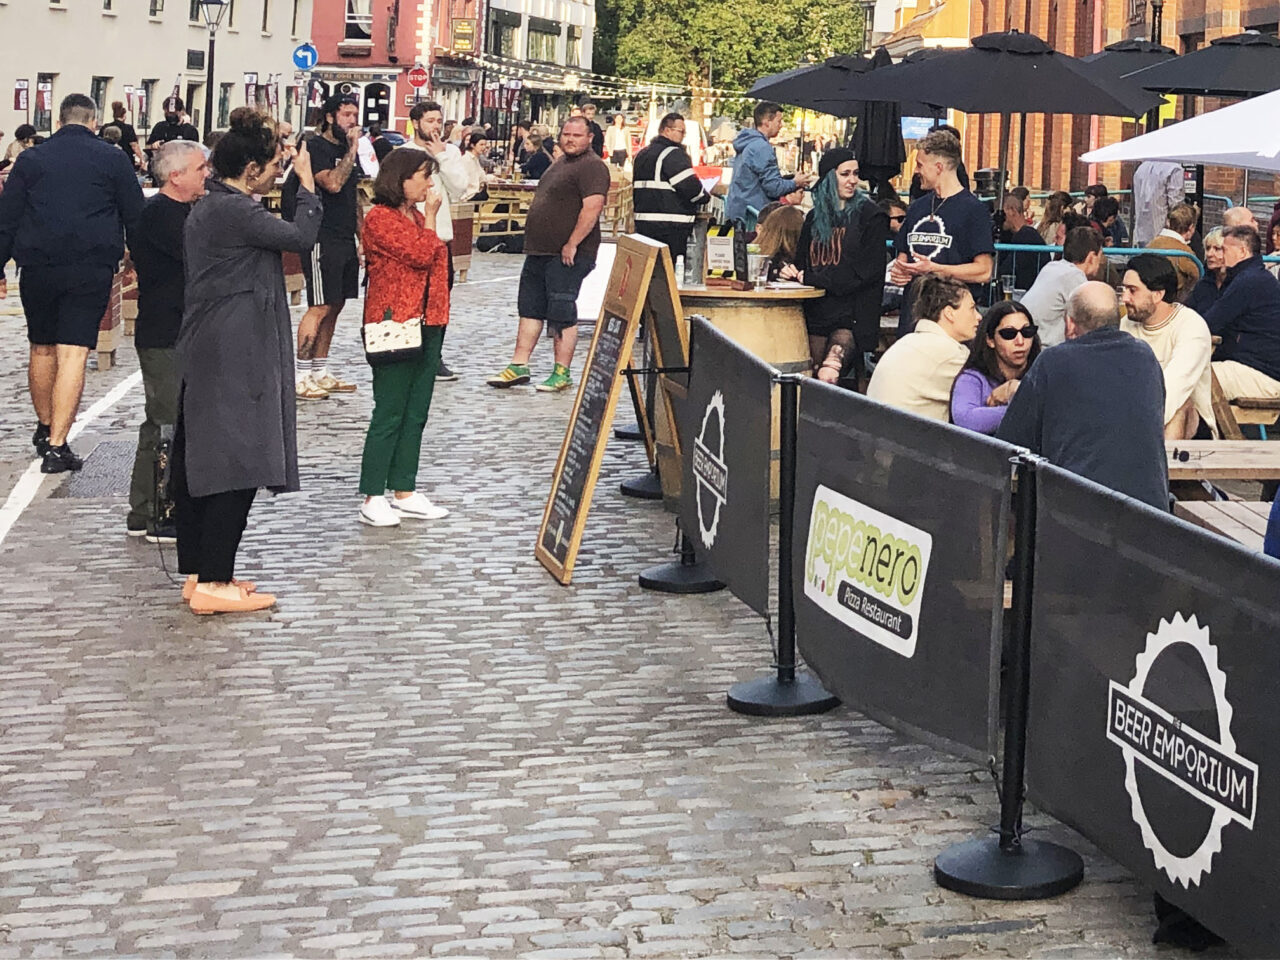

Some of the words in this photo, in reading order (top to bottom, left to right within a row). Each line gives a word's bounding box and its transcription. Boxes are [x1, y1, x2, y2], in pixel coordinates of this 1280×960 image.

[408, 74, 427, 82] STOP
[808, 507, 919, 601] pepenero
[843, 586, 860, 610] Pizza
[861, 596, 902, 632] Restaurant
[1114, 698, 1151, 750] BEER
[1152, 723, 1247, 809] EMPORIUM
